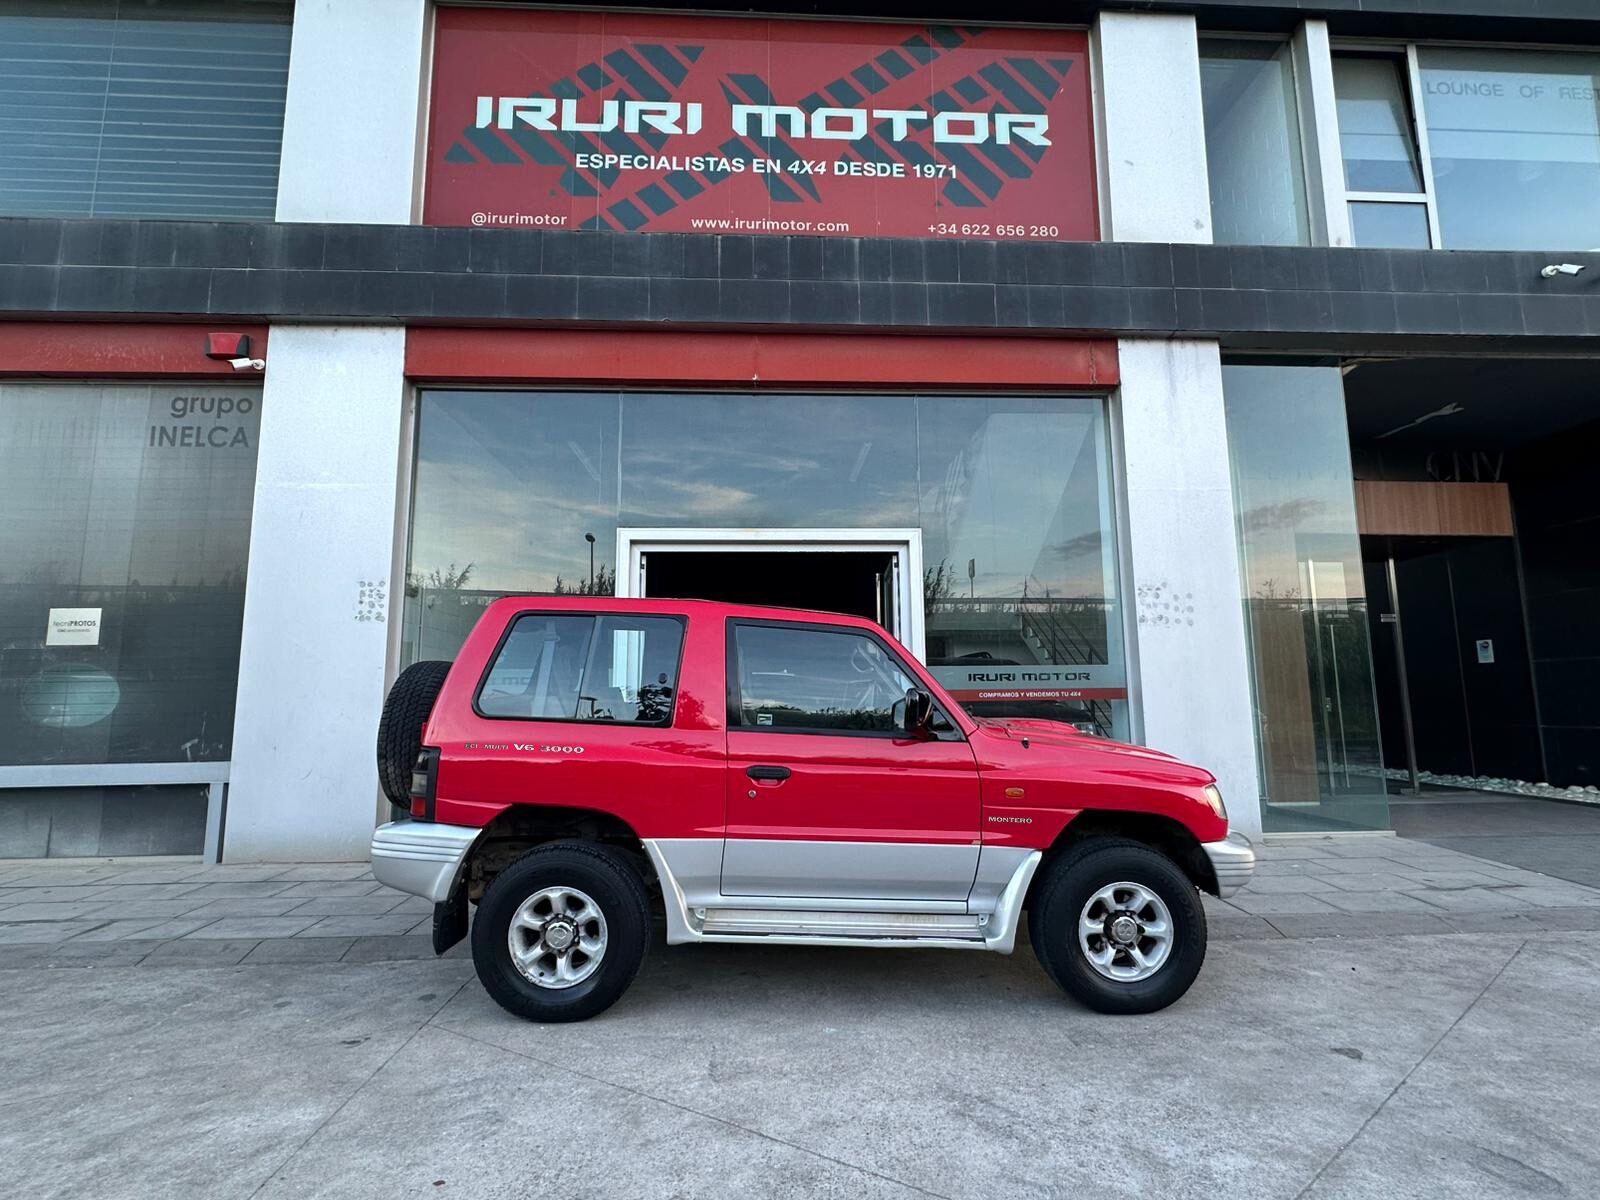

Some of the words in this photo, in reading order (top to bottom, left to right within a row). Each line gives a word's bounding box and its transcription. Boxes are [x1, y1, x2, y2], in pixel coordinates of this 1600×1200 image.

[1426, 81, 1504, 97] LOUNGE
[1519, 85, 1545, 98] OF
[475, 96, 703, 135] IRURI
[731, 104, 1053, 146] MOTOR
[575, 153, 745, 173] ESPECIALISTAS
[752, 158, 781, 174] EN
[787, 159, 827, 175] 4X4
[833, 161, 906, 178] DESDE
[912, 164, 957, 179] 1971
[471, 211, 568, 227] @irurimotor
[690, 217, 850, 232] www.irurimotor.com
[927, 223, 958, 236] +34
[961, 223, 991, 237] 622
[995, 224, 1026, 237] 656
[1029, 225, 1059, 238] 280
[170, 396, 253, 419] grupo
[149, 425, 249, 448] INELCA
[967, 673, 1016, 681] IRURI
[1021, 672, 1091, 681] MOTOR
[513, 743, 535, 751] V6
[541, 744, 585, 754] 3000
[988, 816, 1033, 824] MONTERO
